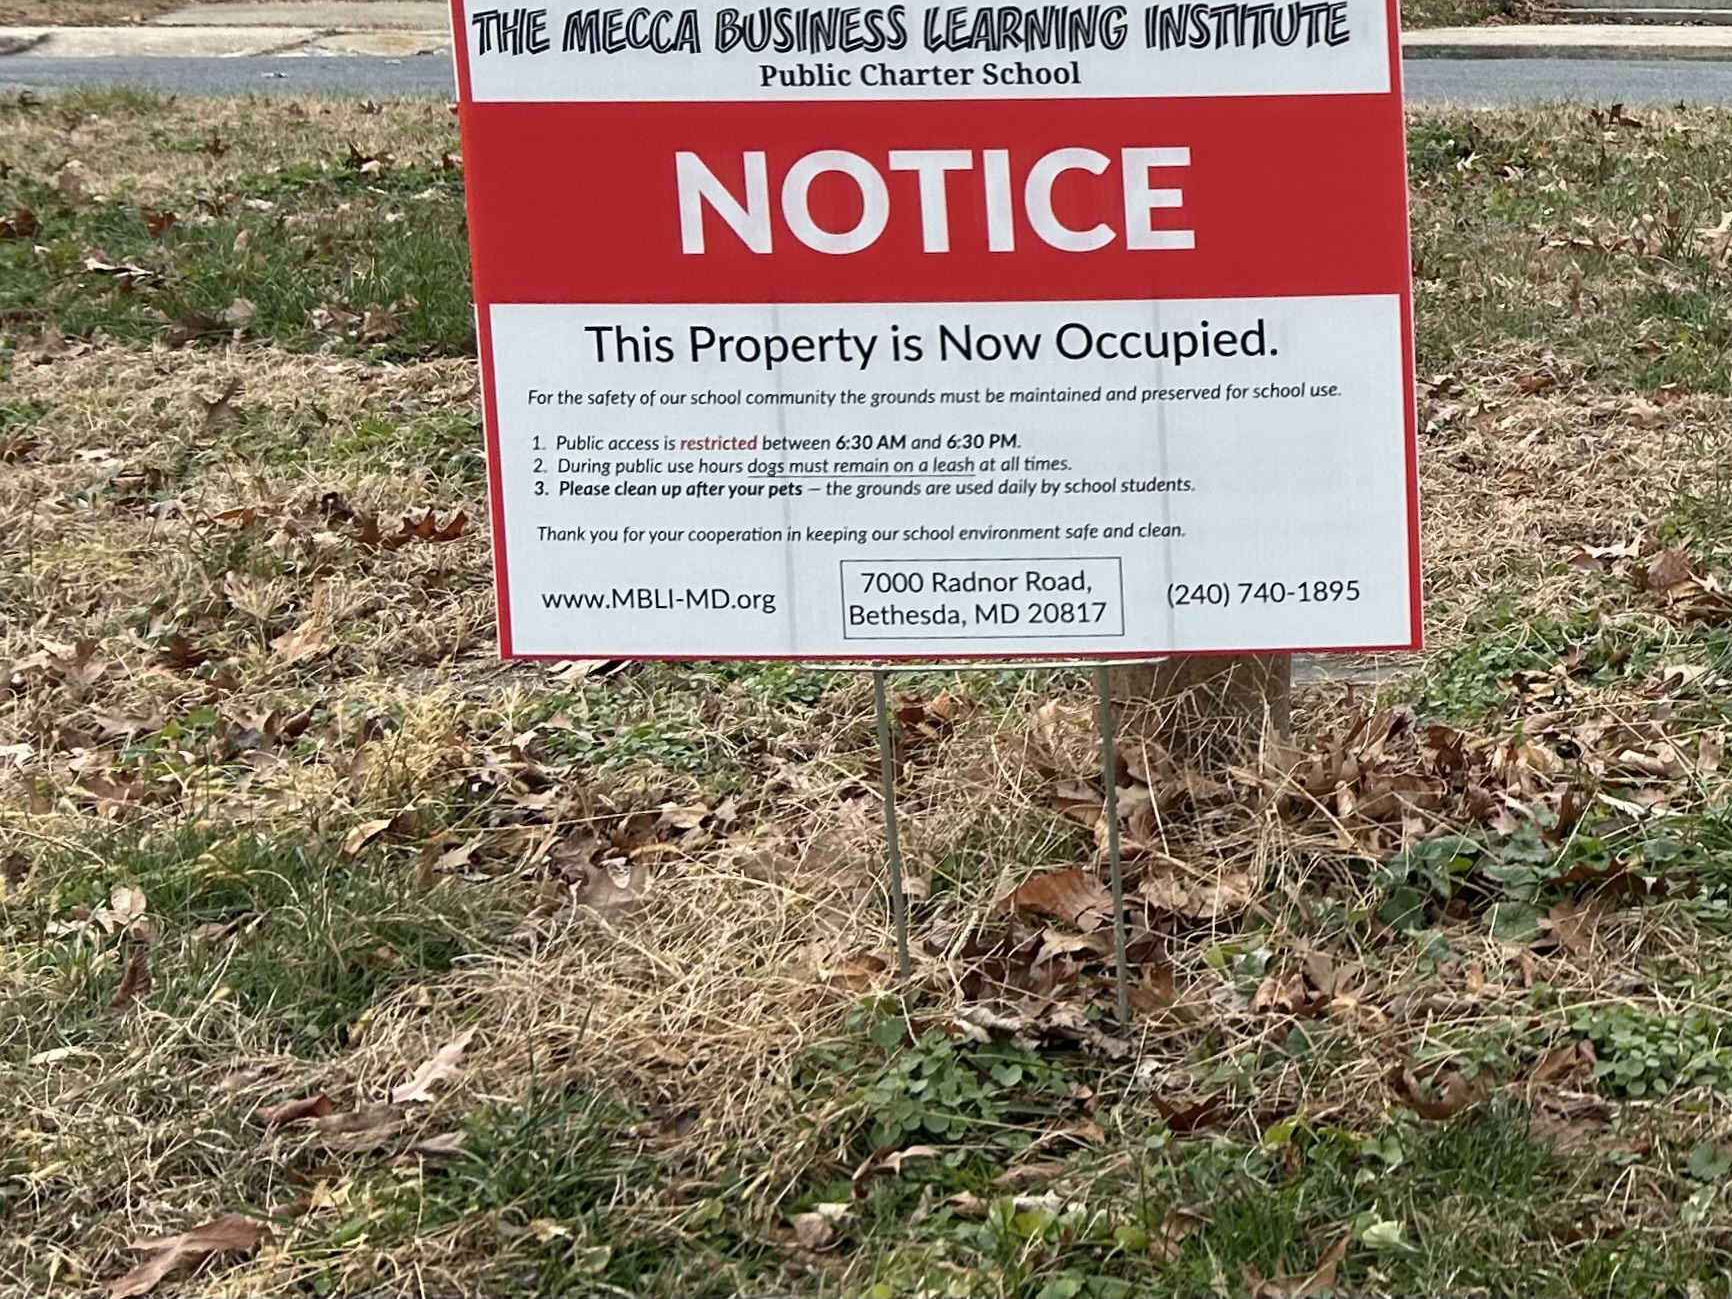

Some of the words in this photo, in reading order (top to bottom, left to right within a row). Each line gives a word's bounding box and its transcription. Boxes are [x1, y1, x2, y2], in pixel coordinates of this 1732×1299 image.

[471, 7, 551, 57] THE
[561, 6, 702, 55] MECCA
[714, 3, 909, 56] BUSINESS
[923, 4, 1129, 55] LEARNING
[1144, 0, 1351, 52] INSTITUTE
[758, 62, 853, 88] Public
[859, 62, 976, 87] Charter
[982, 60, 1083, 86] School
[675, 146, 1196, 255] NOTICE
[583, 324, 675, 364] This
[689, 325, 879, 371] Property
[890, 323, 924, 363] is
[938, 323, 1043, 362] Now
[1055, 317, 1278, 367] Occupied.
[527, 389, 555, 406] For
[557, 389, 584, 406] the
[586, 389, 637, 409] safety
[639, 389, 657, 407] of
[659, 393, 688, 406] our
[689, 388, 742, 406] school
[745, 389, 837, 408] community
[839, 388, 867, 405] the
[869, 388, 936, 408] grounds
[939, 389, 981, 404] must
[984, 387, 1006, 404] be
[1009, 385, 1102, 403] maintained
[1105, 385, 1138, 402] and
[1140, 383, 1222, 405] preserved
[1225, 383, 1250, 402] for
[1252, 381, 1306, 399] school
[1309, 384, 1342, 398] use.
[532, 434, 547, 451] 1.
[555, 434, 605, 451] Public
[607, 438, 660, 452] access
[663, 434, 676, 451] is
[679, 434, 758, 451] restricted
[761, 434, 831, 452] between
[835, 434, 874, 451] 6:30
[875, 433, 907, 451] AM
[910, 433, 943, 450] and
[945, 433, 985, 450] 6:30
[988, 432, 1022, 450] PM.
[532, 457, 548, 474] 2.
[557, 457, 612, 477] During
[614, 457, 664, 477] public
[667, 461, 695, 474] use
[698, 457, 744, 474] hours
[747, 457, 786, 477] dogs
[788, 458, 830, 474] must
[833, 457, 890, 474] remain
[892, 460, 914, 473] on
[918, 460, 929, 473] a
[932, 455, 975, 474] leash
[978, 457, 997, 473] at
[1000, 455, 1021, 472] all
[1023, 455, 1073, 472] times.
[533, 480, 550, 497] 3.
[558, 480, 611, 497] Please
[613, 479, 658, 497] clean
[661, 484, 683, 500] up
[685, 480, 726, 499] after
[727, 484, 766, 500] your
[767, 481, 804, 500] pets
[825, 480, 853, 497] the
[855, 479, 922, 500] grounds
[926, 481, 952, 497] are
[955, 478, 995, 496] used
[997, 477, 1038, 498] daily
[1040, 477, 1062, 498] by
[1063, 476, 1117, 494] school
[1120, 476, 1196, 494] students.
[536, 525, 587, 542] Thank
[589, 529, 619, 545] you
[622, 525, 646, 544] for
[648, 529, 686, 545] your
[687, 526, 783, 546] cooperation
[786, 525, 802, 543] in
[805, 525, 869, 545] keeping
[871, 529, 901, 542] our
[902, 524, 955, 542] school
[958, 524, 1062, 541] environment
[1064, 523, 1099, 542] safe
[1102, 521, 1135, 539] and
[1138, 521, 1186, 539] clean.
[860, 571, 925, 594] 7000
[931, 570, 1020, 593] Radnor
[1025, 569, 1093, 595] Road,
[1166, 581, 1231, 610] (240)
[1237, 579, 1361, 605] 740-1895
[541, 587, 777, 615] www.MBLI-MD.org
[849, 603, 967, 629] Bethesda,
[974, 603, 1021, 625] MD
[1027, 601, 1108, 624] 20817
